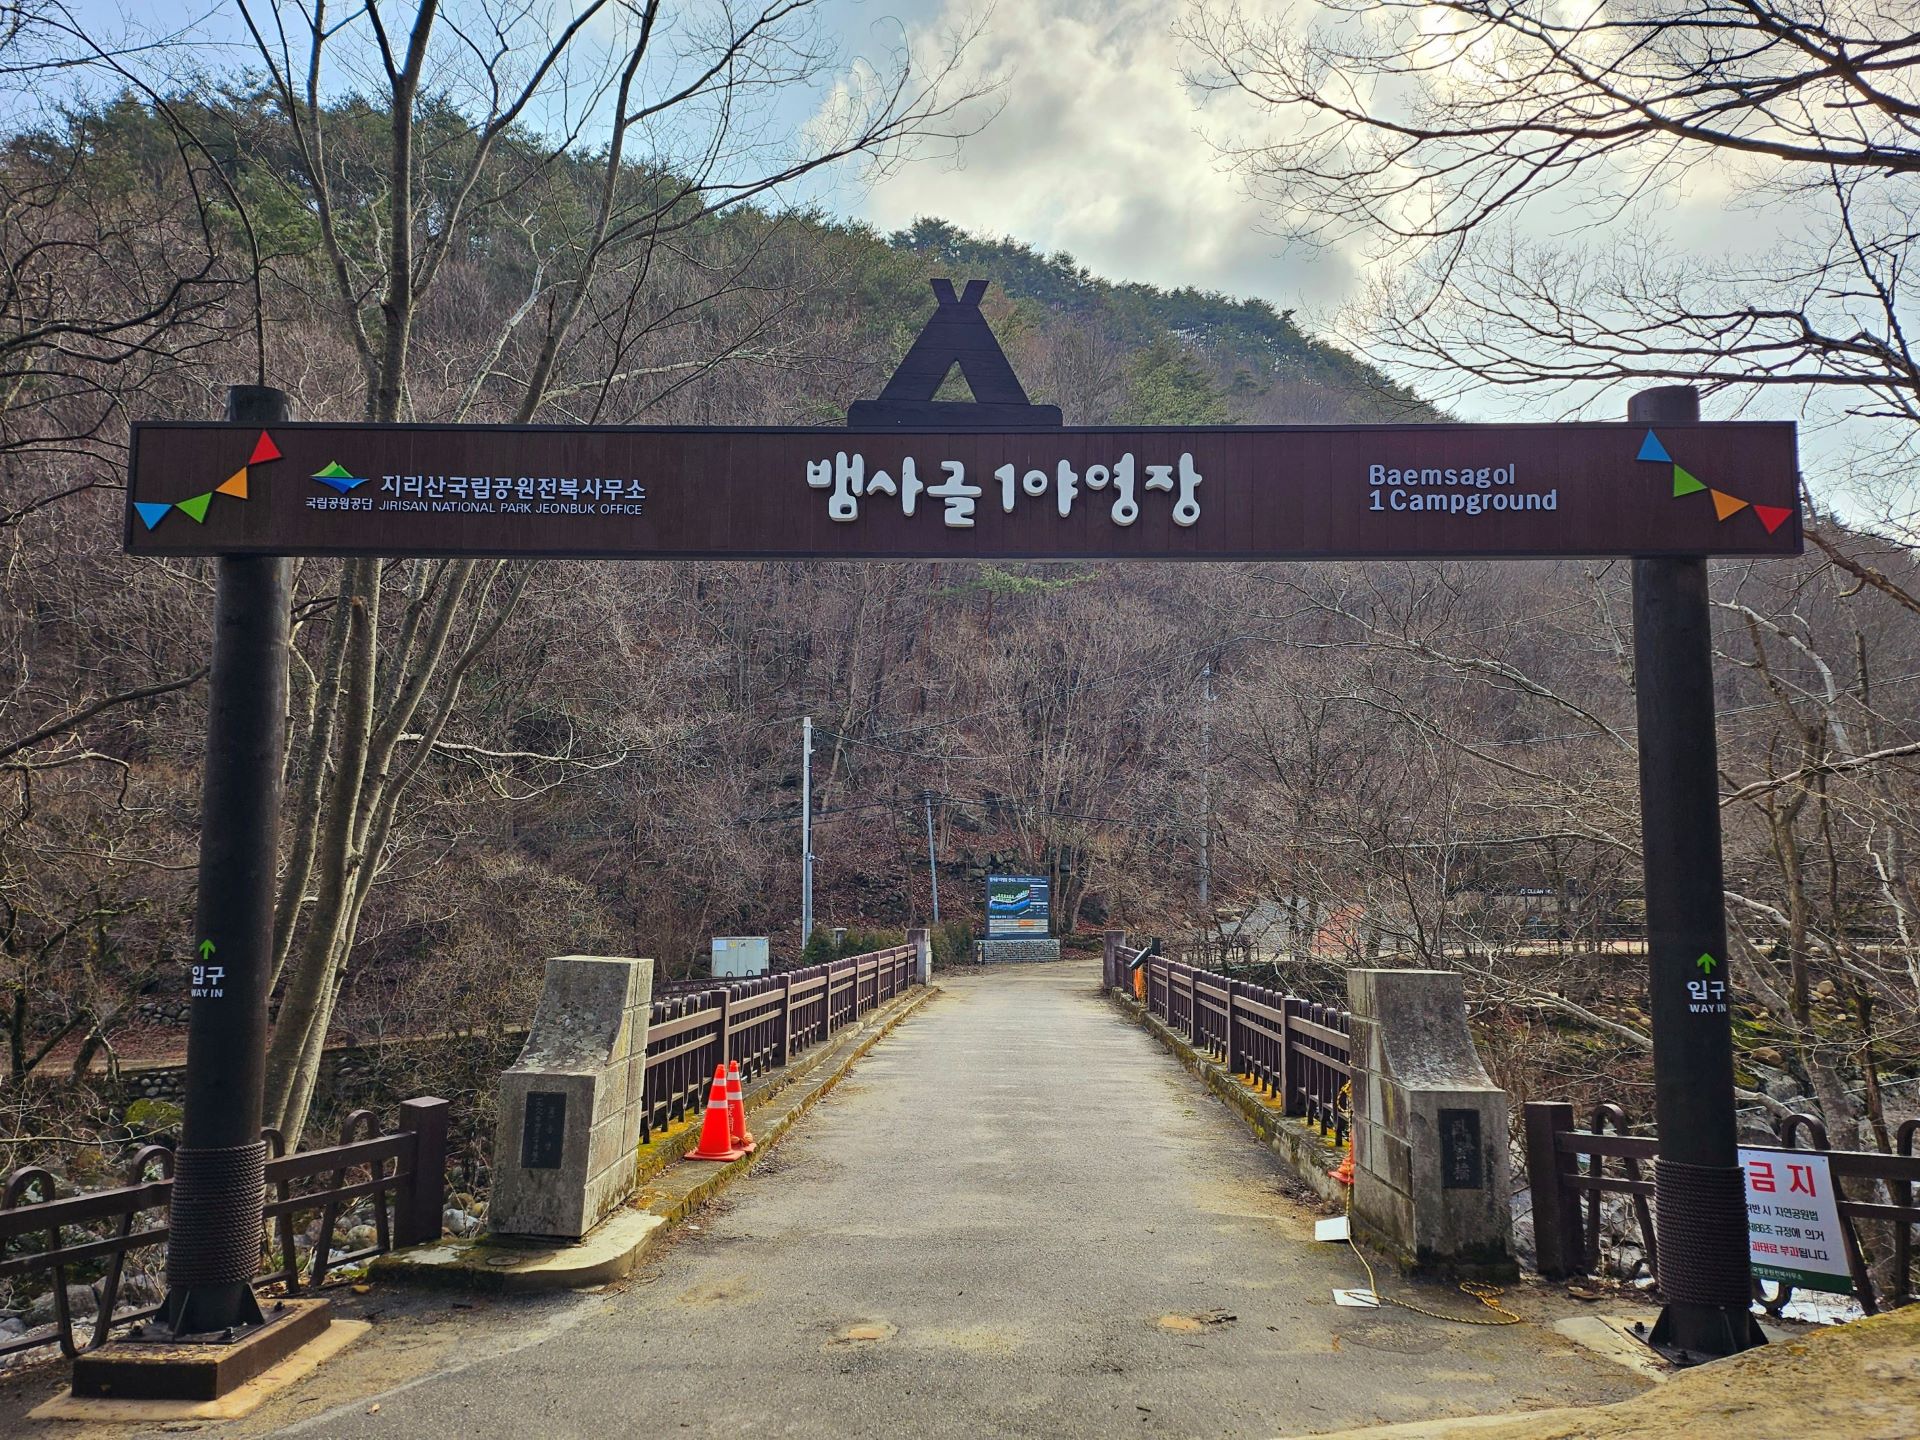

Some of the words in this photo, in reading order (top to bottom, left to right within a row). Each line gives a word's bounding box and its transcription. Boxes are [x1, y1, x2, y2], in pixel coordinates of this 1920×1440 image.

[1369, 463, 1515, 489] Baemsagol
[380, 474, 646, 501] 지리산국립공원전북사무소
[806, 450, 982, 527] 뱀사골
[994, 452, 1203, 527] 1야영장
[305, 497, 373, 511] 국립공원공단
[379, 500, 428, 512] JIRISAN
[432, 501, 496, 514] NATIONAL
[500, 502, 532, 514] PARK
[536, 503, 596, 514] JEONBUK
[600, 504, 642, 515] OFFICE
[1369, 489, 1384, 511] 1
[1389, 489, 1557, 515] Campground
[191, 965, 225, 986] 입구
[190, 988, 208, 998] WAY
[210, 988, 223, 998] IN
[1687, 980, 1726, 1000] 입구
[1689, 1003, 1715, 1013] WAY
[1717, 1003, 1727, 1013] IN
[1774, 1206, 1819, 1222] 자연공원법
[1774, 1225, 1801, 1239] 규정에
[1804, 1229, 1825, 1242] 의거
[1752, 1241, 1779, 1255] 과태료
